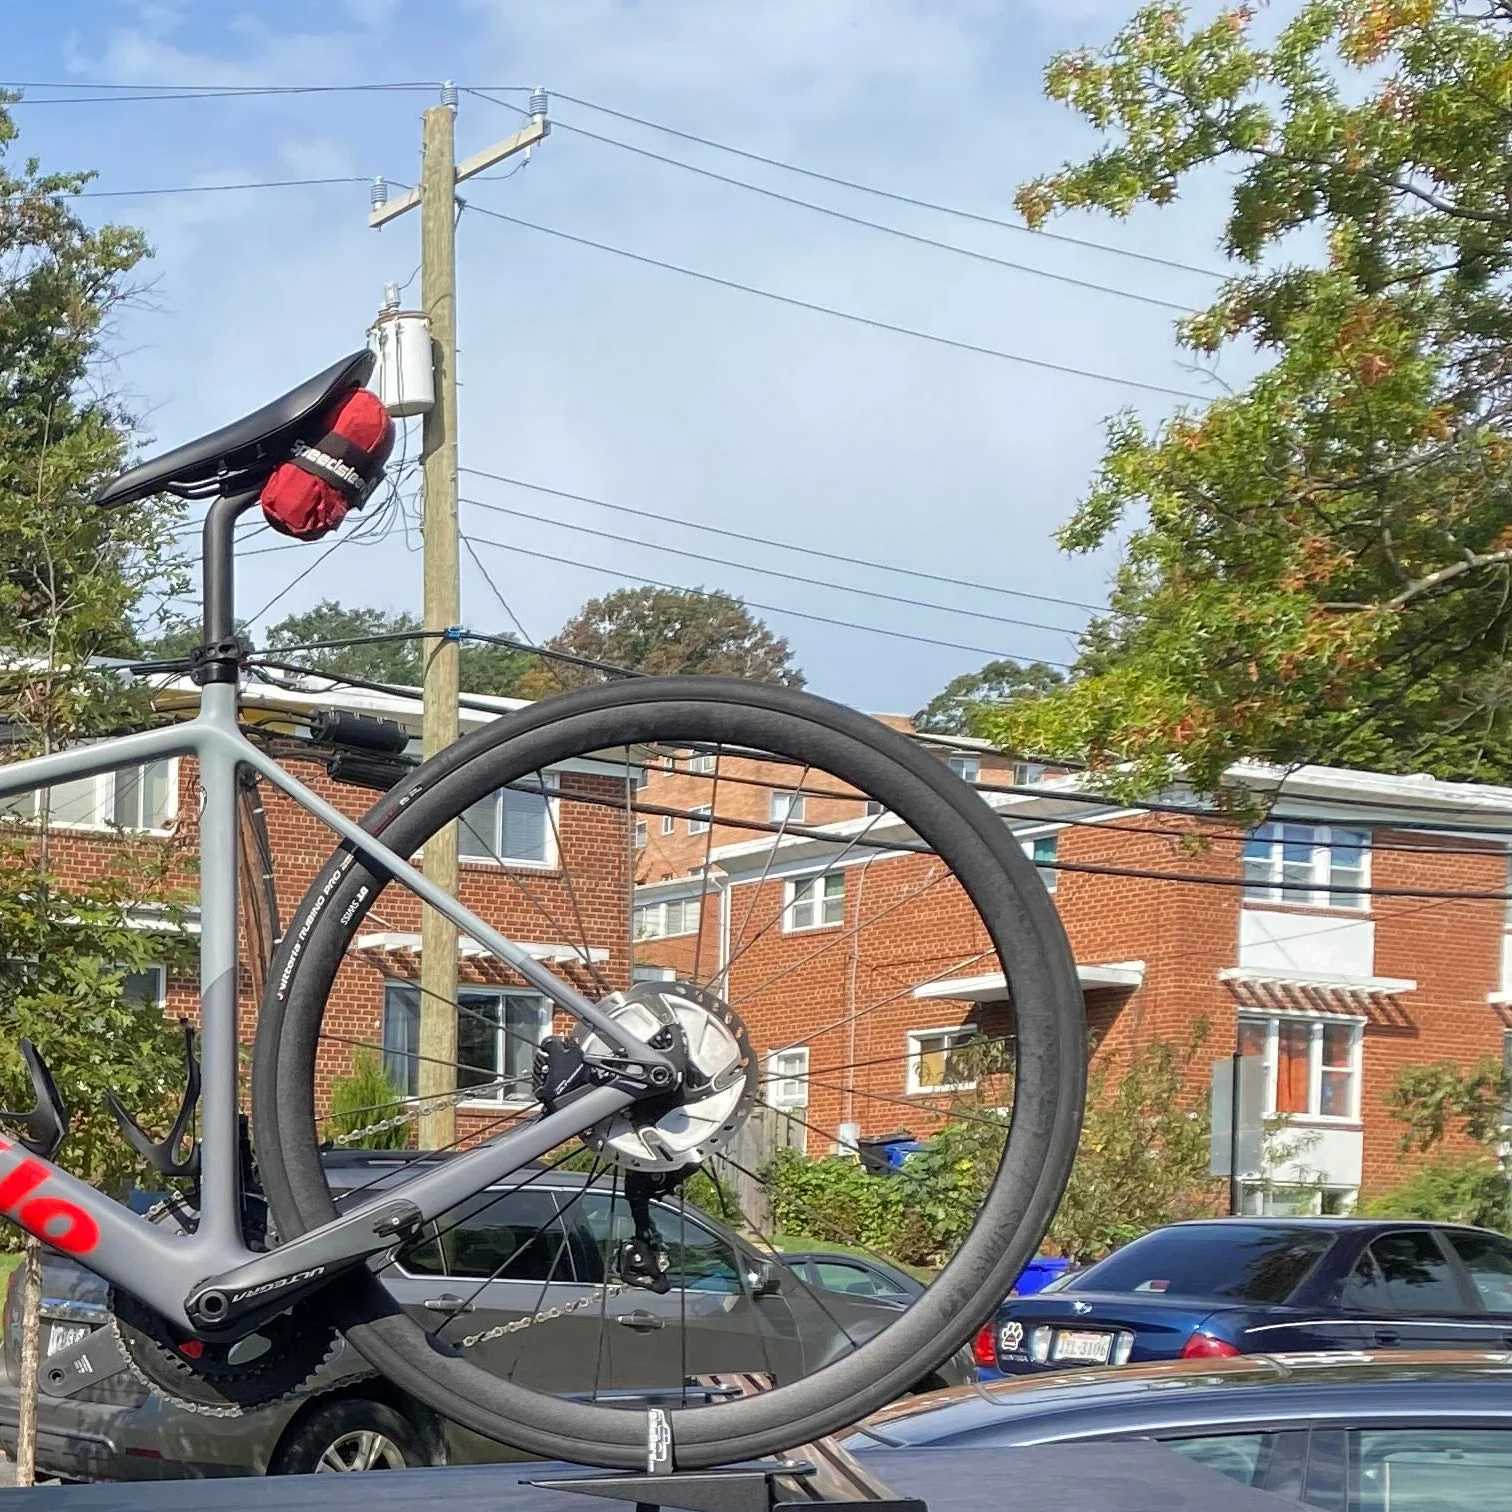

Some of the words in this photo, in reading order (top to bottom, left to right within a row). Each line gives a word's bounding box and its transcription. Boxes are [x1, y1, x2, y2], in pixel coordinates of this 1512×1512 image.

[298, 896, 327, 942] RUBINO
[323, 869, 342, 896] PRO
[340, 899, 361, 927] SWISS
[231, 1265, 326, 1303] ULTEGRA
